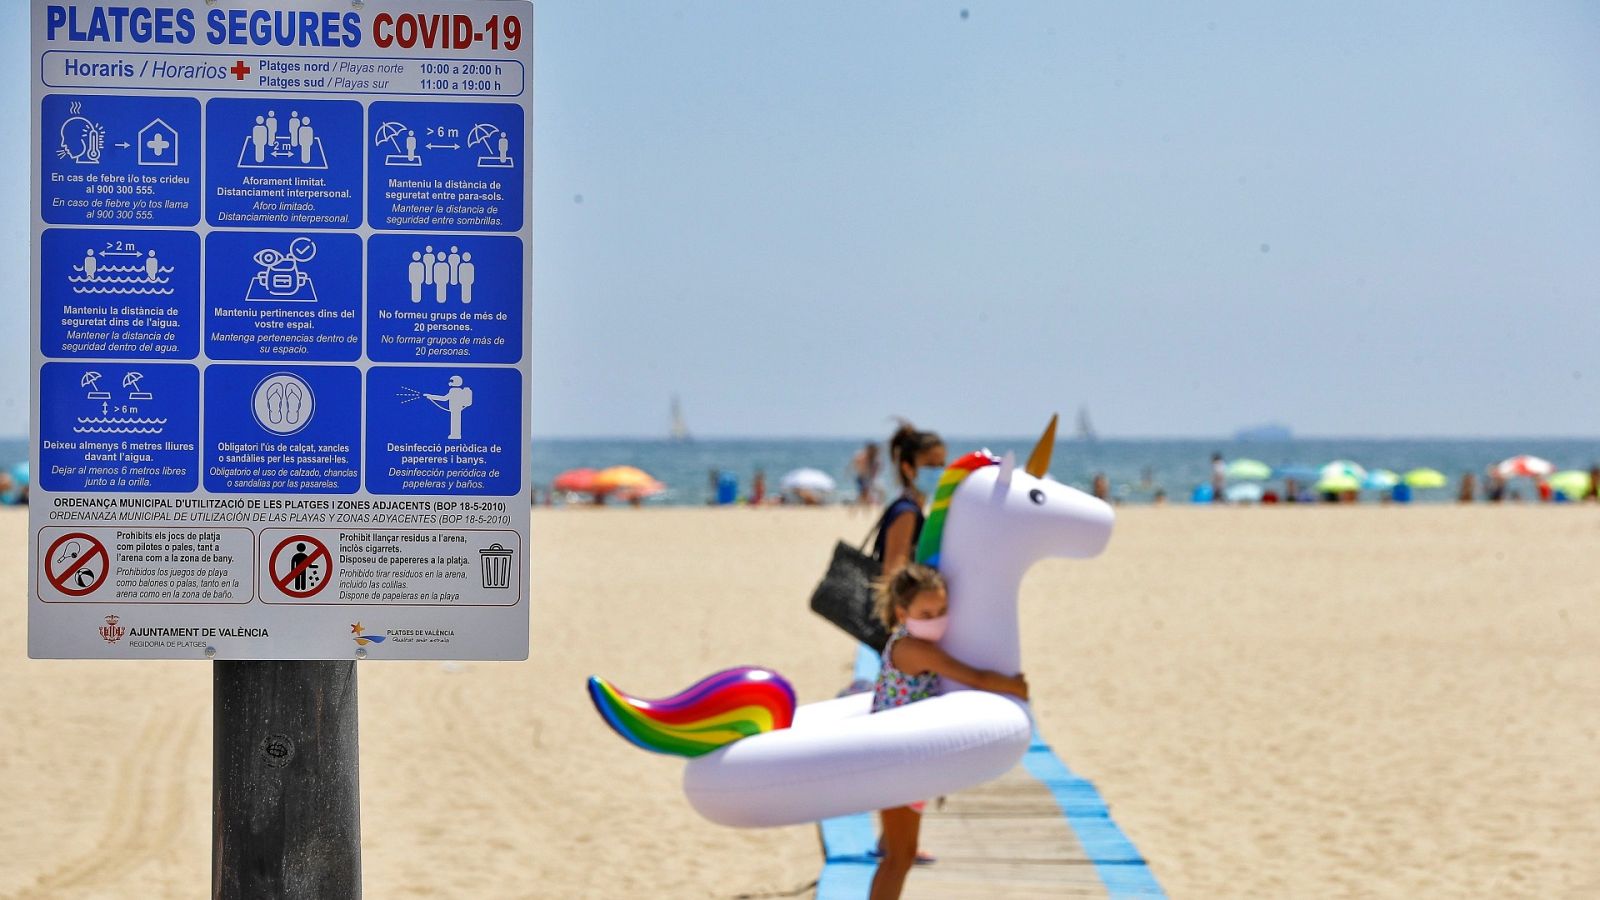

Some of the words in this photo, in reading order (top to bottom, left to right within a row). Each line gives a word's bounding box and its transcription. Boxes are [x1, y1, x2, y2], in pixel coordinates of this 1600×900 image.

[46, 4, 196, 45] PLATGES
[206, 8, 362, 48] SEGURES
[372, 12, 522, 52] COVID-19
[65, 58, 134, 78] Horaris
[152, 60, 227, 79] Horarios
[260, 60, 300, 74] Platges
[304, 61, 330, 72] nord
[340, 62, 374, 75] Playas
[377, 64, 404, 74] norte
[420, 63, 450, 74] 10:00
[452, 66, 459, 74] a
[462, 64, 492, 75] 20:00
[495, 64, 502, 75] h
[260, 76, 300, 89] Platges
[304, 77, 324, 88] sud
[334, 77, 369, 90] Playas
[372, 80, 389, 88] sur
[420, 79, 449, 90] 11:00
[452, 82, 458, 90] a
[462, 80, 491, 90] 19:00
[494, 80, 501, 91] h
[437, 126, 444, 138] 6
[448, 128, 459, 138] m
[52, 172, 64, 182] En
[86, 173, 98, 182] de
[100, 173, 125, 183] febre
[128, 174, 140, 183] i/o
[142, 175, 158, 184] tos
[160, 174, 190, 184] crideu
[242, 176, 292, 186] Aforament
[294, 177, 326, 186] limitat.
[388, 178, 432, 188] Manteniu
[434, 180, 442, 188] la
[445, 180, 487, 189] distància
[490, 180, 501, 190] de
[86, 184, 94, 194] al
[96, 184, 114, 194] 900
[116, 185, 133, 194] 300
[136, 186, 155, 194] 555.
[217, 187, 284, 197] Distanciament
[287, 188, 352, 199] interpersonal.
[385, 191, 430, 201] seguretat
[432, 192, 456, 200] entre
[458, 192, 504, 202] para-sols.
[252, 201, 277, 210] Aforo
[278, 202, 316, 211] limitado.
[116, 240, 122, 250] 2
[64, 305, 107, 314] Manteniu
[110, 306, 118, 315] la
[121, 306, 164, 316] distància
[166, 307, 178, 316] de
[214, 307, 258, 317] Manteniu
[260, 308, 316, 319] pertinences
[318, 309, 338, 318] dins
[340, 309, 355, 318] del
[379, 310, 392, 319] No
[394, 310, 428, 319] formeu
[430, 312, 458, 322] grups
[460, 311, 472, 320] de
[474, 311, 494, 320] més
[496, 312, 508, 320] de
[61, 318, 107, 328] seguretat
[109, 317, 130, 326] dins
[132, 318, 144, 327] de
[254, 320, 284, 328] vostre
[286, 320, 314, 330] espai.
[414, 322, 425, 332] 20
[427, 324, 473, 332] persones.
[122, 405, 128, 414] 6
[44, 440, 76, 450] Deixeu
[79, 441, 119, 452] almenys
[121, 441, 128, 450] 6
[130, 442, 162, 450] metres
[165, 441, 194, 451] lliures
[218, 442, 258, 454] Obligatori
[277, 443, 288, 452] de
[289, 443, 316, 454] calçat,
[318, 444, 350, 452] xancles
[387, 442, 442, 452] Desinfecció
[444, 444, 488, 454] periòdica
[490, 444, 502, 453] de
[84, 452, 117, 461] davant
[226, 454, 266, 463] sandàlies
[267, 456, 281, 464] per
[283, 454, 295, 463] les
[401, 456, 448, 465] papereres
[450, 455, 454, 463] i
[456, 455, 487, 466] banys.
[54, 498, 118, 510] ORDENANÇA
[120, 498, 173, 508] MUNICIPAL
[247, 500, 260, 509] DE
[263, 500, 282, 509] LES
[284, 500, 329, 510] PLATGES
[332, 500, 334, 510] I
[337, 500, 370, 510] ZONES
[372, 501, 431, 510] ADJACENTS
[433, 501, 457, 512] (BOP
[460, 502, 506, 513] 18-5-2010)
[49, 510, 117, 520] ORDENANAZA
[118, 511, 171, 521] MUNICIPAL
[173, 512, 188, 521] DE
[190, 511, 250, 522] UTILIZACIÓN
[252, 512, 267, 522] DE
[268, 512, 288, 522] LAS
[289, 513, 326, 522] PLAYAS
[328, 513, 336, 522] Y
[336, 513, 370, 523] ZONAS
[371, 514, 437, 524] ADYACENTES
[438, 514, 463, 526] (BOP
[465, 514, 510, 526] 18-5-2010)
[116, 531, 152, 540] Prohibits
[154, 531, 166, 540] els
[167, 531, 185, 542] jocs
[187, 532, 197, 540] de
[198, 532, 220, 542] platja
[340, 532, 371, 542] Prohibit
[372, 533, 400, 544] llançar
[401, 533, 430, 542] residus
[340, 554, 376, 566] Disposeu
[378, 555, 388, 564] de
[390, 557, 429, 566] papereres
[437, 556, 444, 564] la
[446, 556, 470, 566] platja.
[129, 628, 200, 637] AJUNTAMENT
[202, 628, 216, 637] DE
[218, 628, 269, 637] VALÈNCIA
